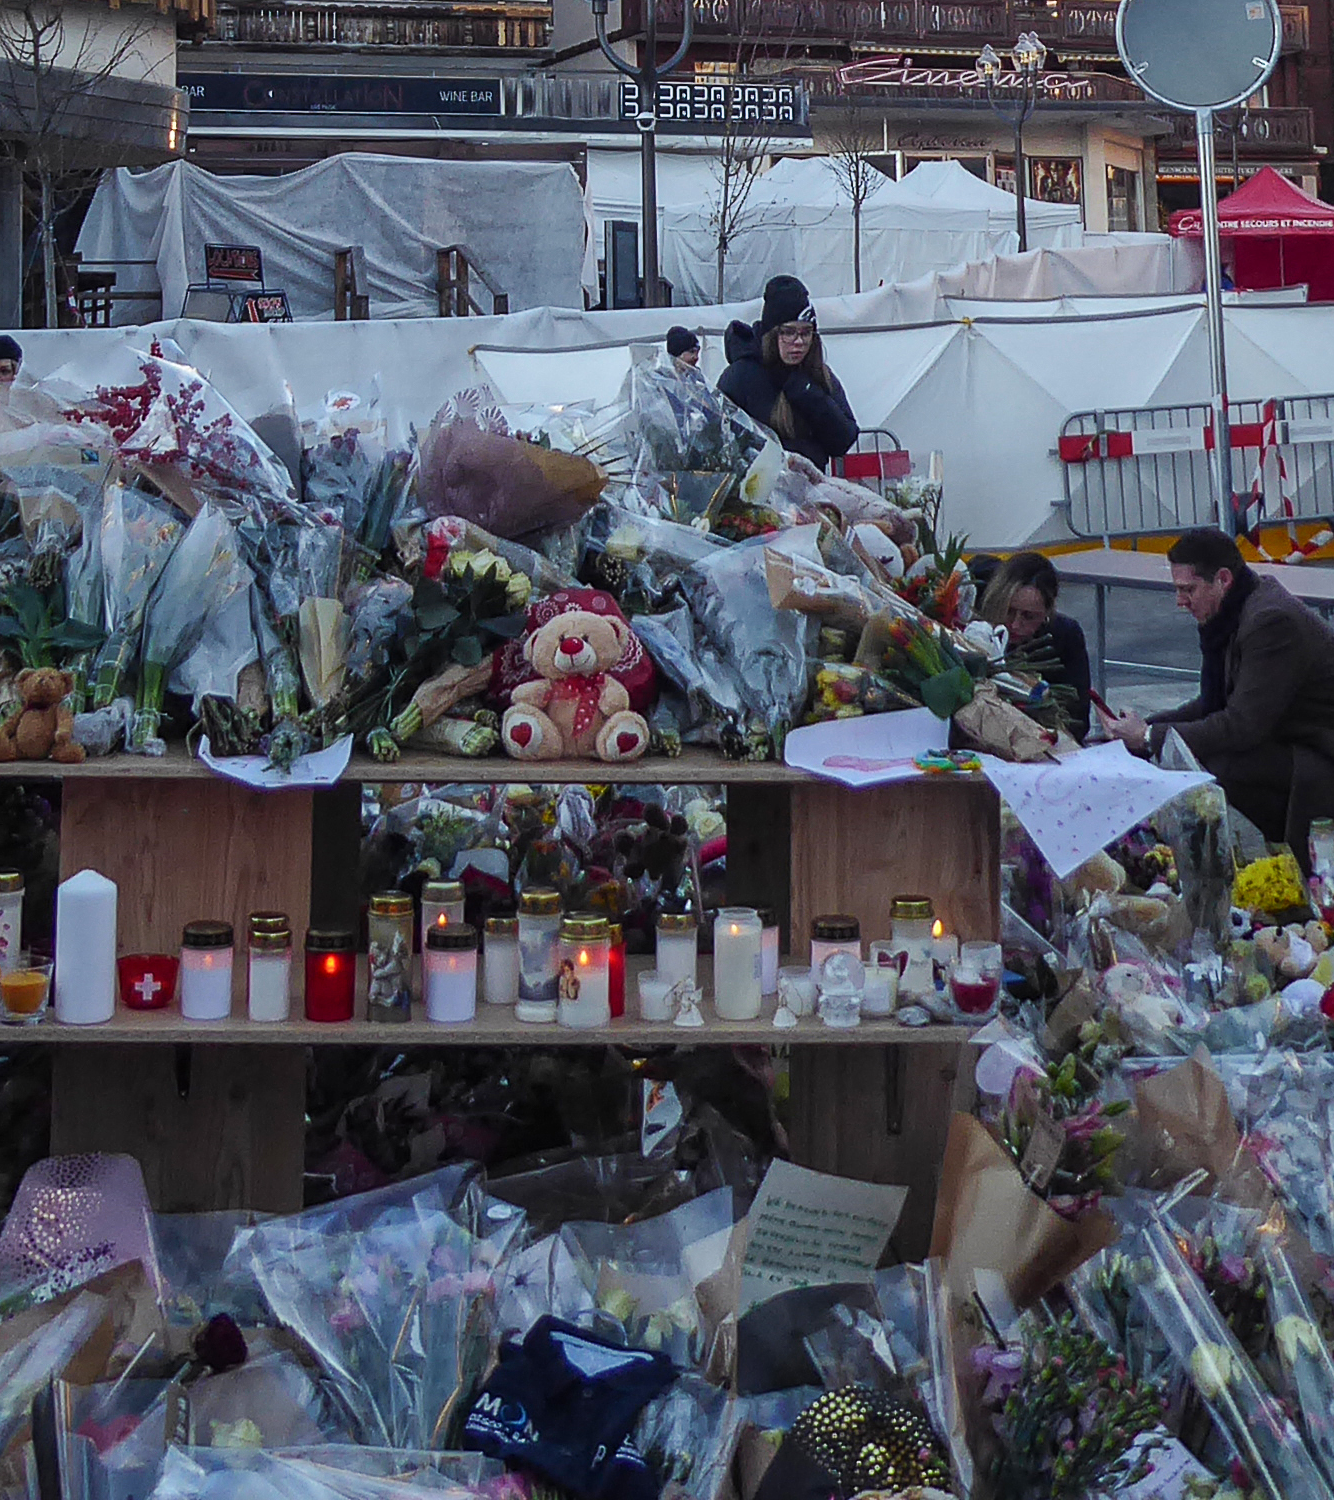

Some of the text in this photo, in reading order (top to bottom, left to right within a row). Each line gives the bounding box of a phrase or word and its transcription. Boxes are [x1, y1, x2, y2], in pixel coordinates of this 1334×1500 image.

[837, 53, 1089, 90] Cinema
[439, 90, 467, 102] WINE
[471, 91, 493, 102] BAR
[1241, 219, 1279, 229] SECOURS
[1280, 219, 1291, 228] ET
[1292, 219, 1334, 228] INCENDIE
